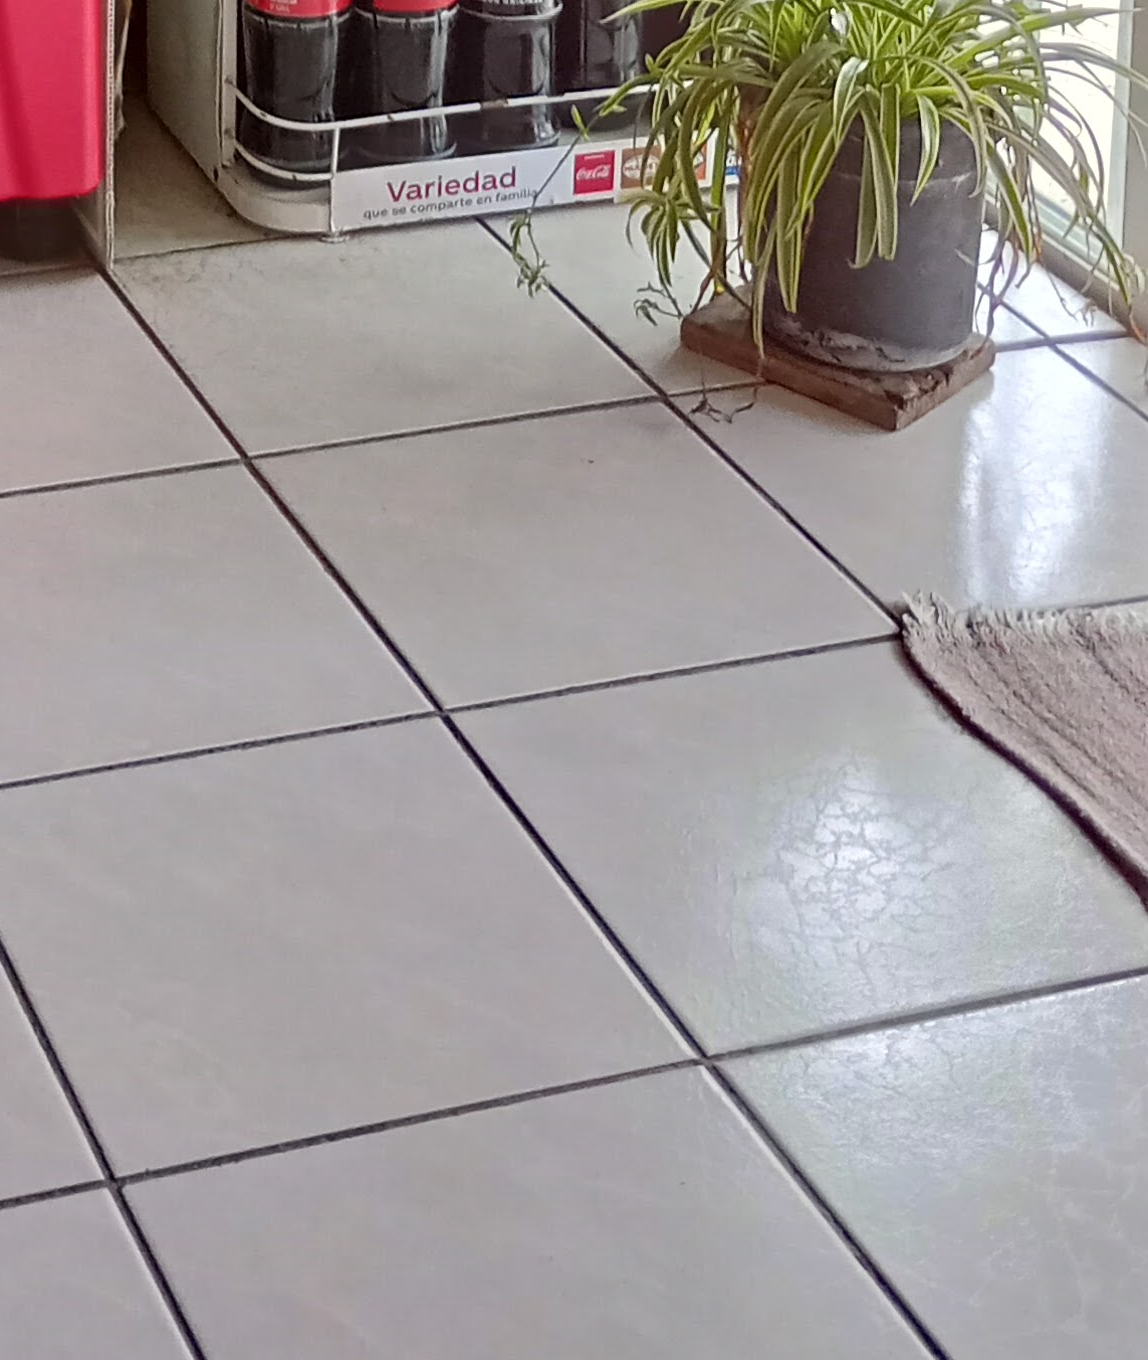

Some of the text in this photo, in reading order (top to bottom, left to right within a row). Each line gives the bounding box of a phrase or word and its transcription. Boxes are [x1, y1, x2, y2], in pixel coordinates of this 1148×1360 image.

[386, 165, 517, 203] Variedad
[363, 189, 538, 221] que se comparte en familia
